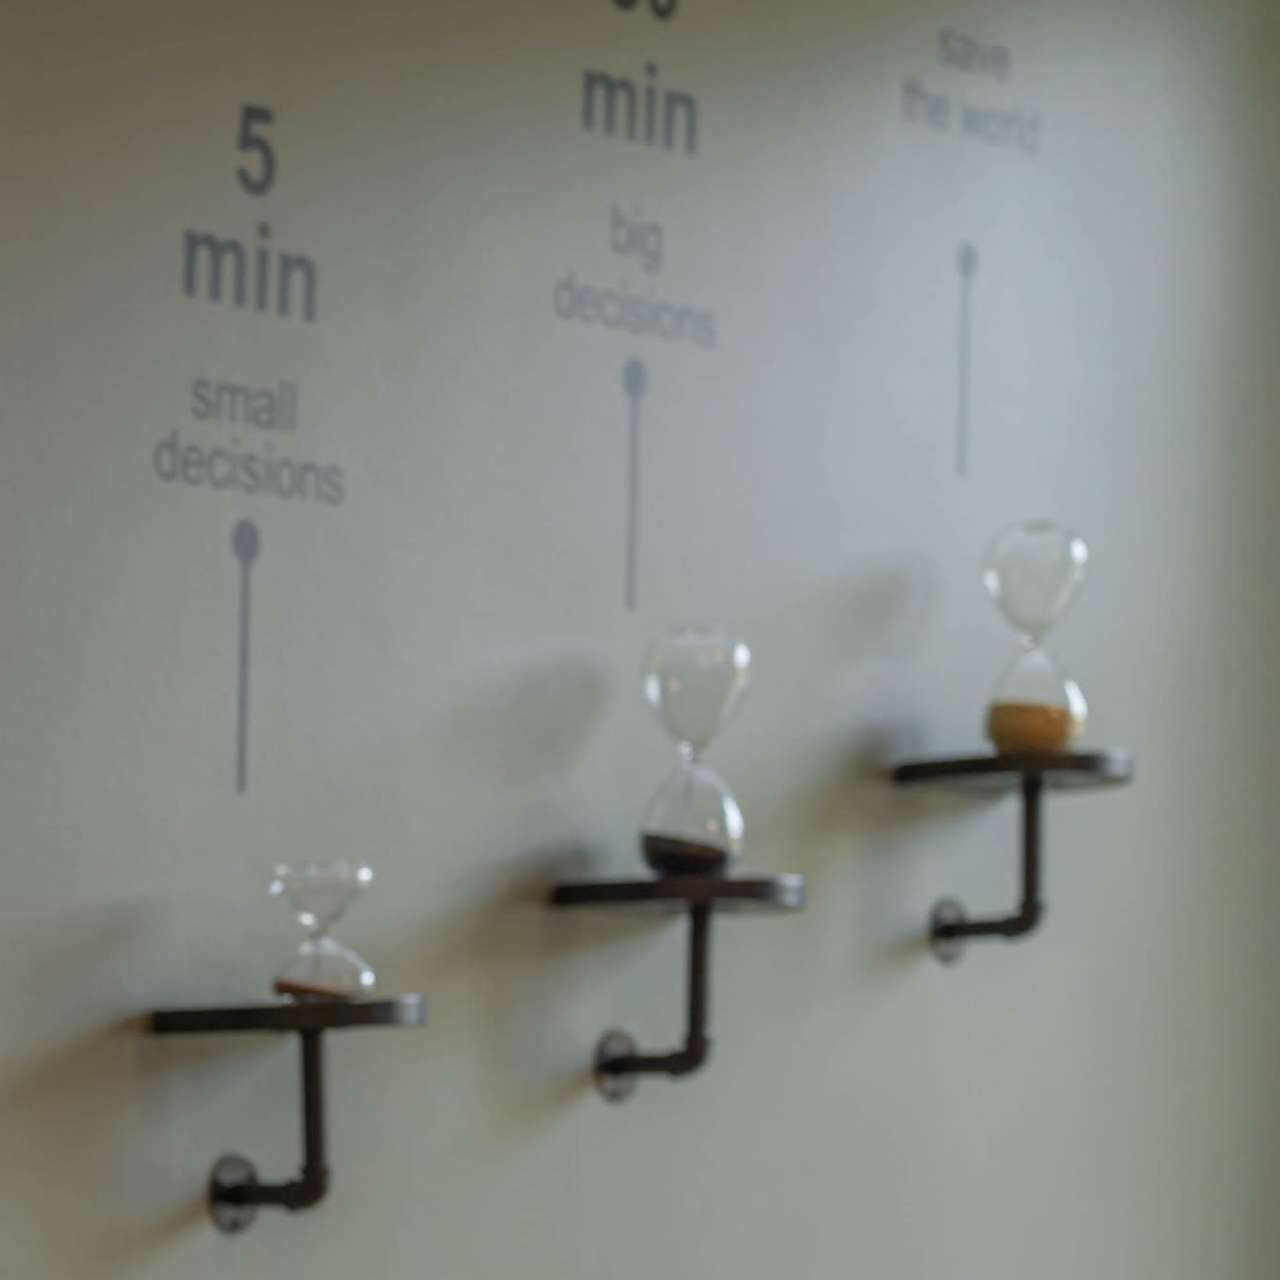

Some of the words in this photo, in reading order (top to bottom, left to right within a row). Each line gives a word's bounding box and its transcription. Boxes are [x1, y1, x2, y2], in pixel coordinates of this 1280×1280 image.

[938, 27, 1012, 82] save
[581, 60, 696, 155] min
[236, 104, 277, 197] 5
[181, 220, 318, 323] min
[610, 202, 664, 275] big
[553, 268, 720, 349] decisions
[189, 377, 300, 432] small
[153, 429, 345, 506] decisions
